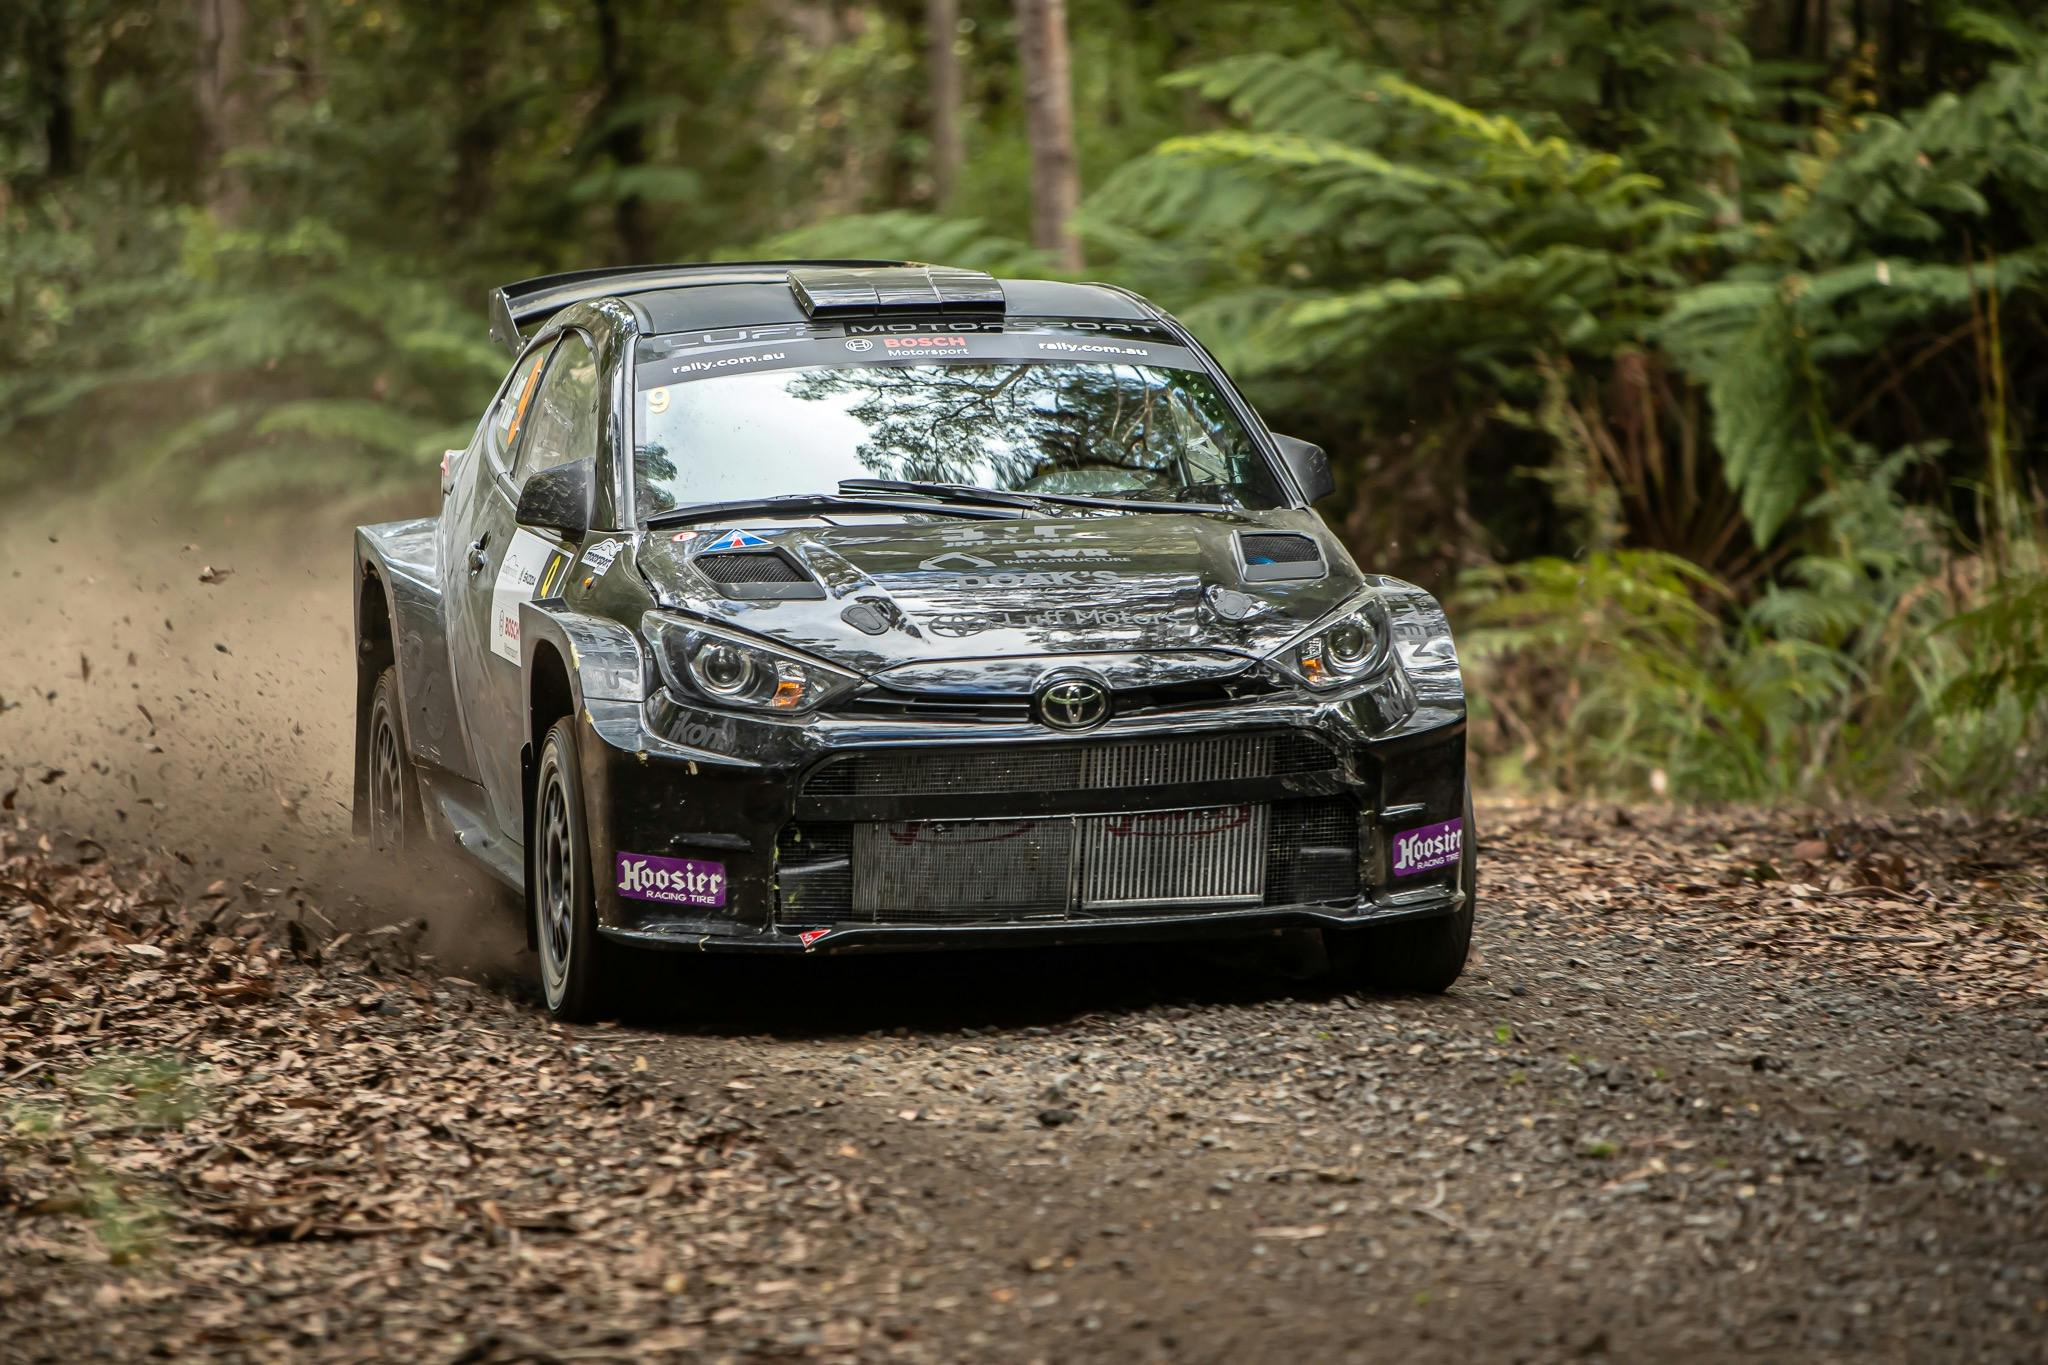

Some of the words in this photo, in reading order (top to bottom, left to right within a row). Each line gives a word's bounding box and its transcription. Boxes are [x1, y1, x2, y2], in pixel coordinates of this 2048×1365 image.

[883, 336, 967, 348] BOSCH
[1038, 342, 1149, 357] rally.com.au
[888, 347, 969, 358] Motorsport
[672, 352, 786, 374] rally.com.au
[648, 386, 671, 414] 9
[1013, 548, 1110, 559] PWR
[956, 571, 1120, 589] DOAK'S
[1073, 608, 1181, 627] Motors
[1393, 824, 1463, 870] Hoosier
[617, 858, 724, 894] Hoosier
[646, 890, 687, 902] RACING
[689, 894, 716, 905] TIRE
